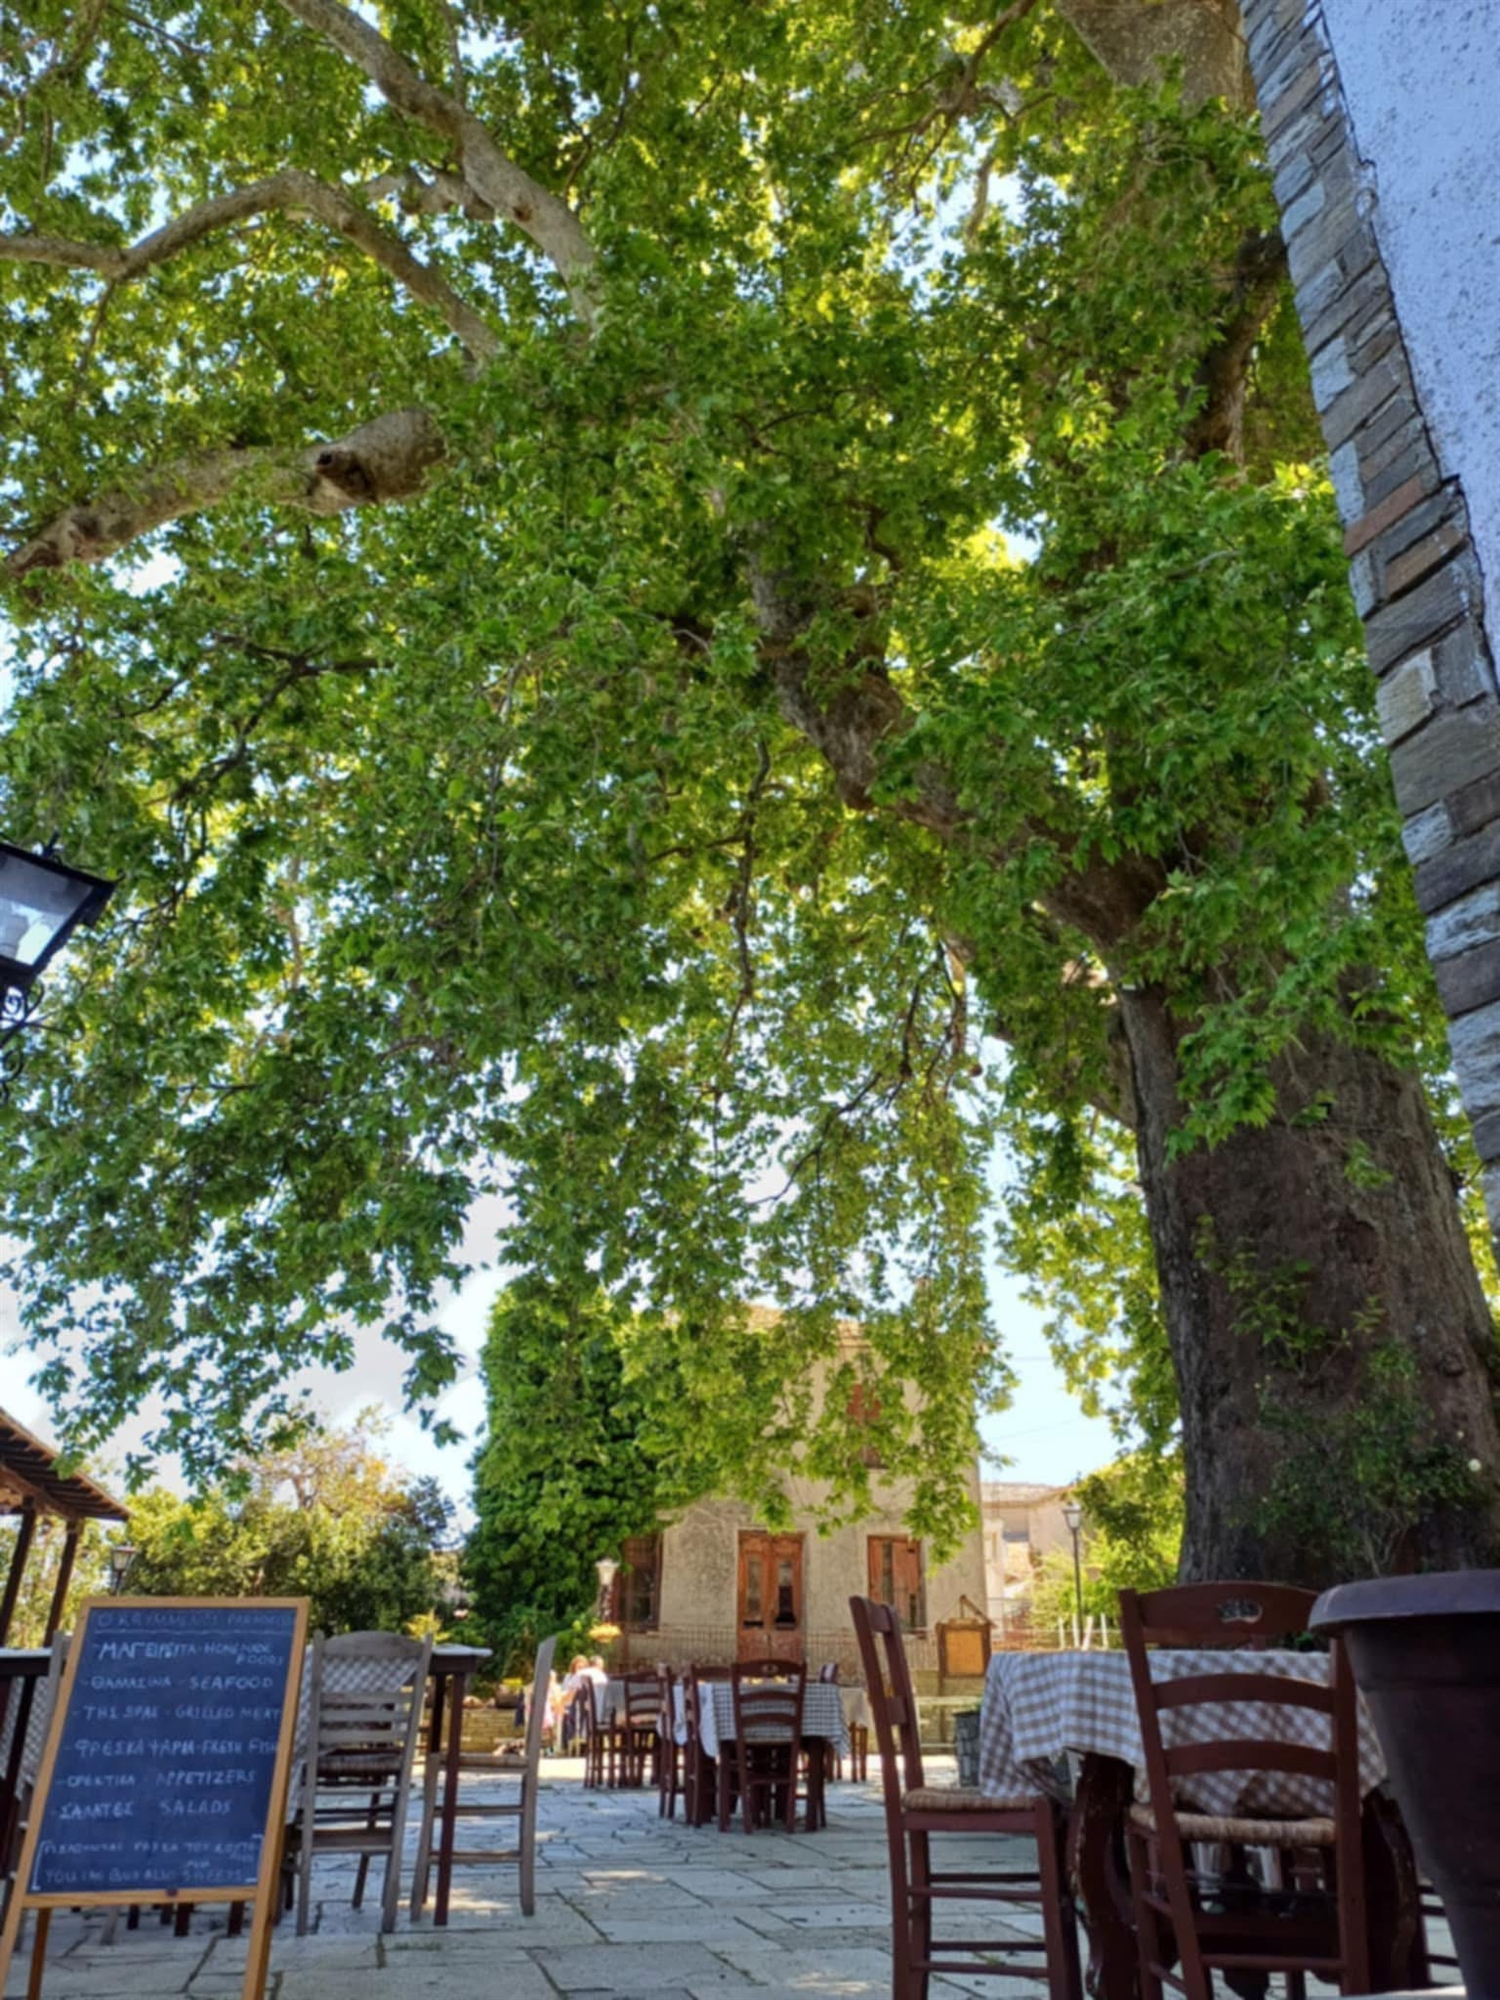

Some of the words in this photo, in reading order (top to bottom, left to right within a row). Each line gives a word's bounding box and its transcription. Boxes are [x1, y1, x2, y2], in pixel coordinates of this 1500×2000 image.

[189, 1675, 274, 1690] SEAFOOD
[155, 1769, 257, 1786] APPETIZERS
[158, 1799, 234, 1816] SALADS
